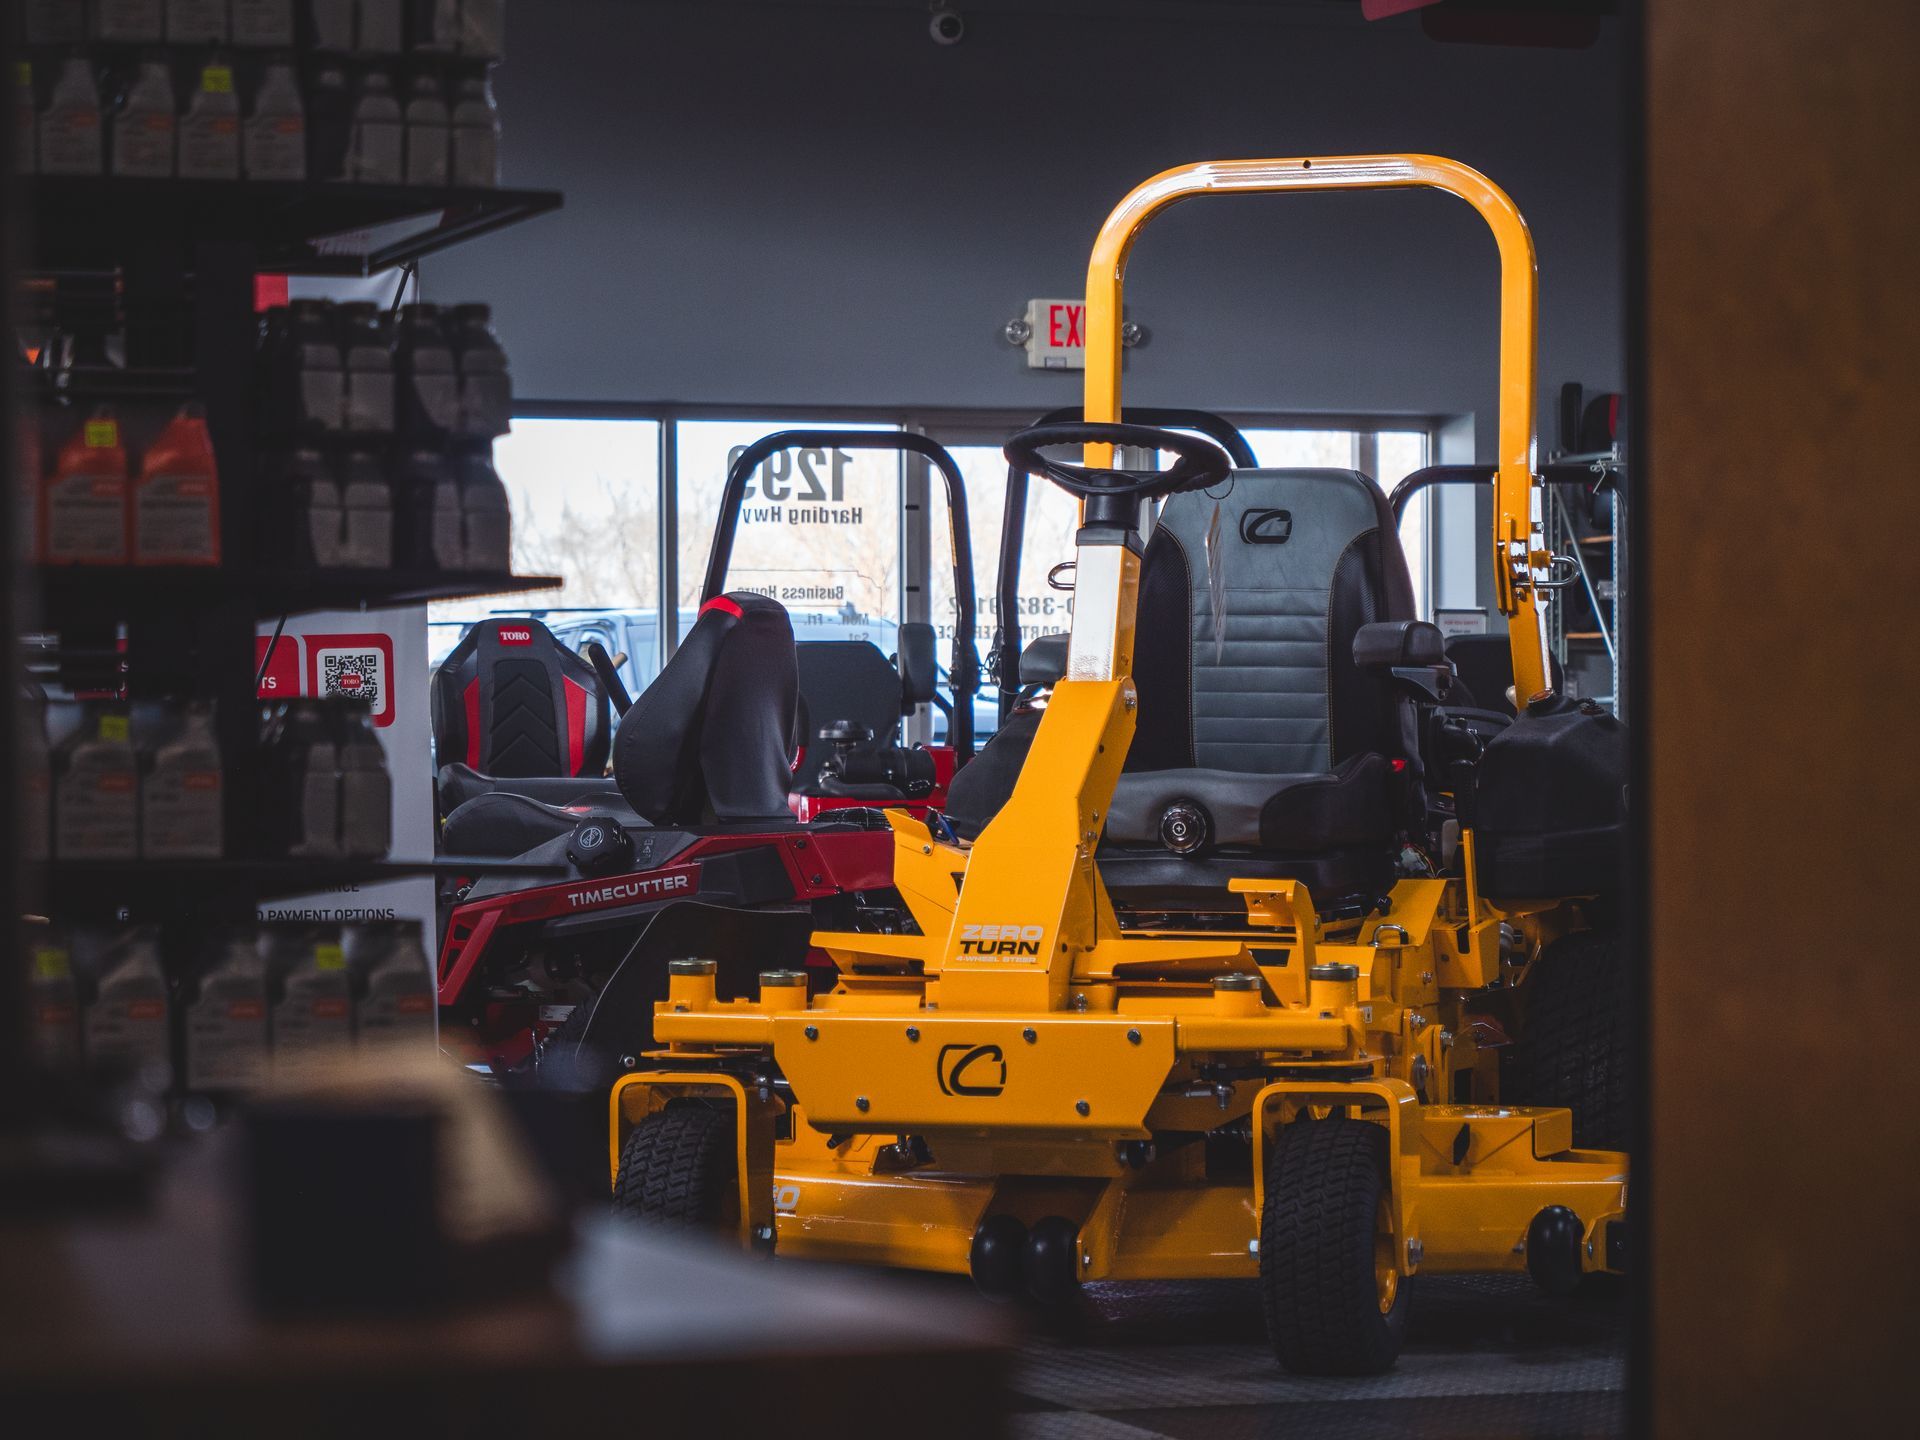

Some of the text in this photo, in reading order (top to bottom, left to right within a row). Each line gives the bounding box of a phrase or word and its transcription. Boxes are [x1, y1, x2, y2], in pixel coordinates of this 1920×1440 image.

[500, 631, 530, 641] TORO
[568, 875, 688, 906] TIMECUTTER
[268, 909, 331, 921] PAYMENT
[335, 908, 395, 921] OPTIONS
[961, 925, 1043, 940] ZERO
[960, 941, 1040, 955] TURN
